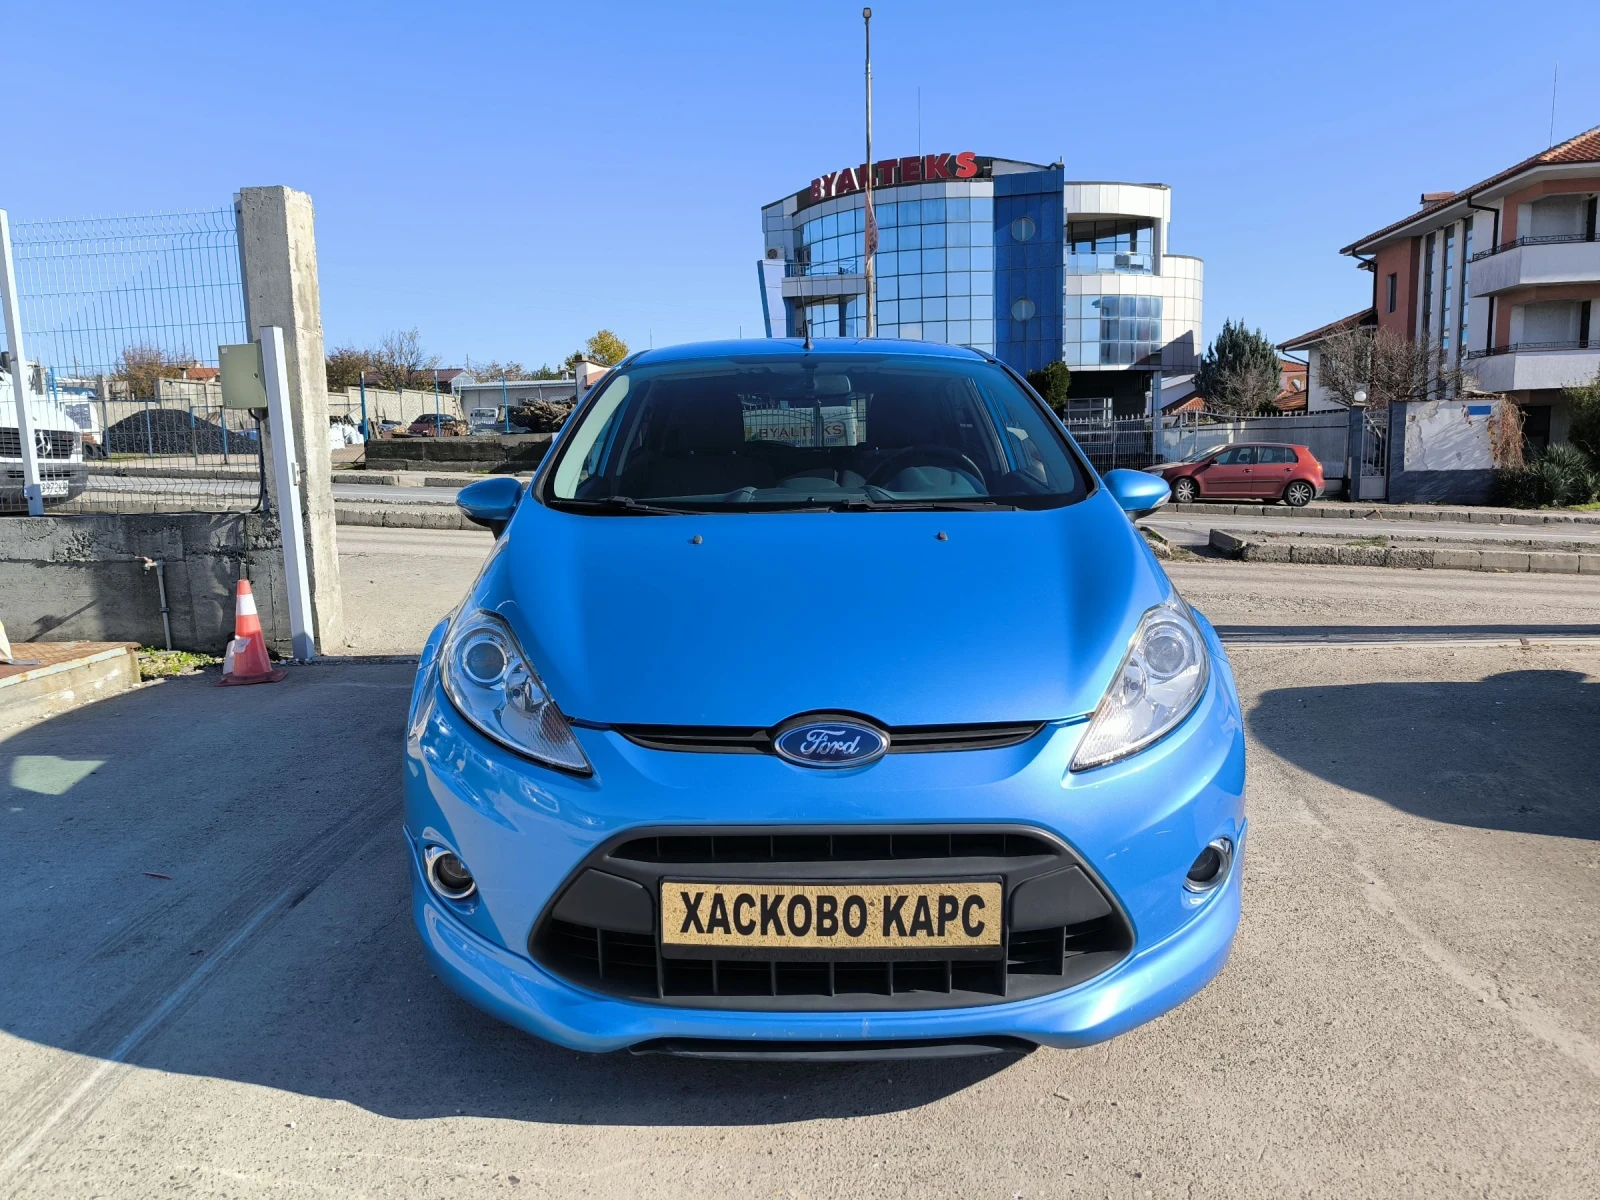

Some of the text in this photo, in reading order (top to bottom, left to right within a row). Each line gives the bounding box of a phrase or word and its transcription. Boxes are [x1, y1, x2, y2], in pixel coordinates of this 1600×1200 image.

[810, 151, 978, 202] BYALTEKS
[800, 729, 861, 755] Ford
[680, 891, 986, 938] ХАСКОВО КАРС
